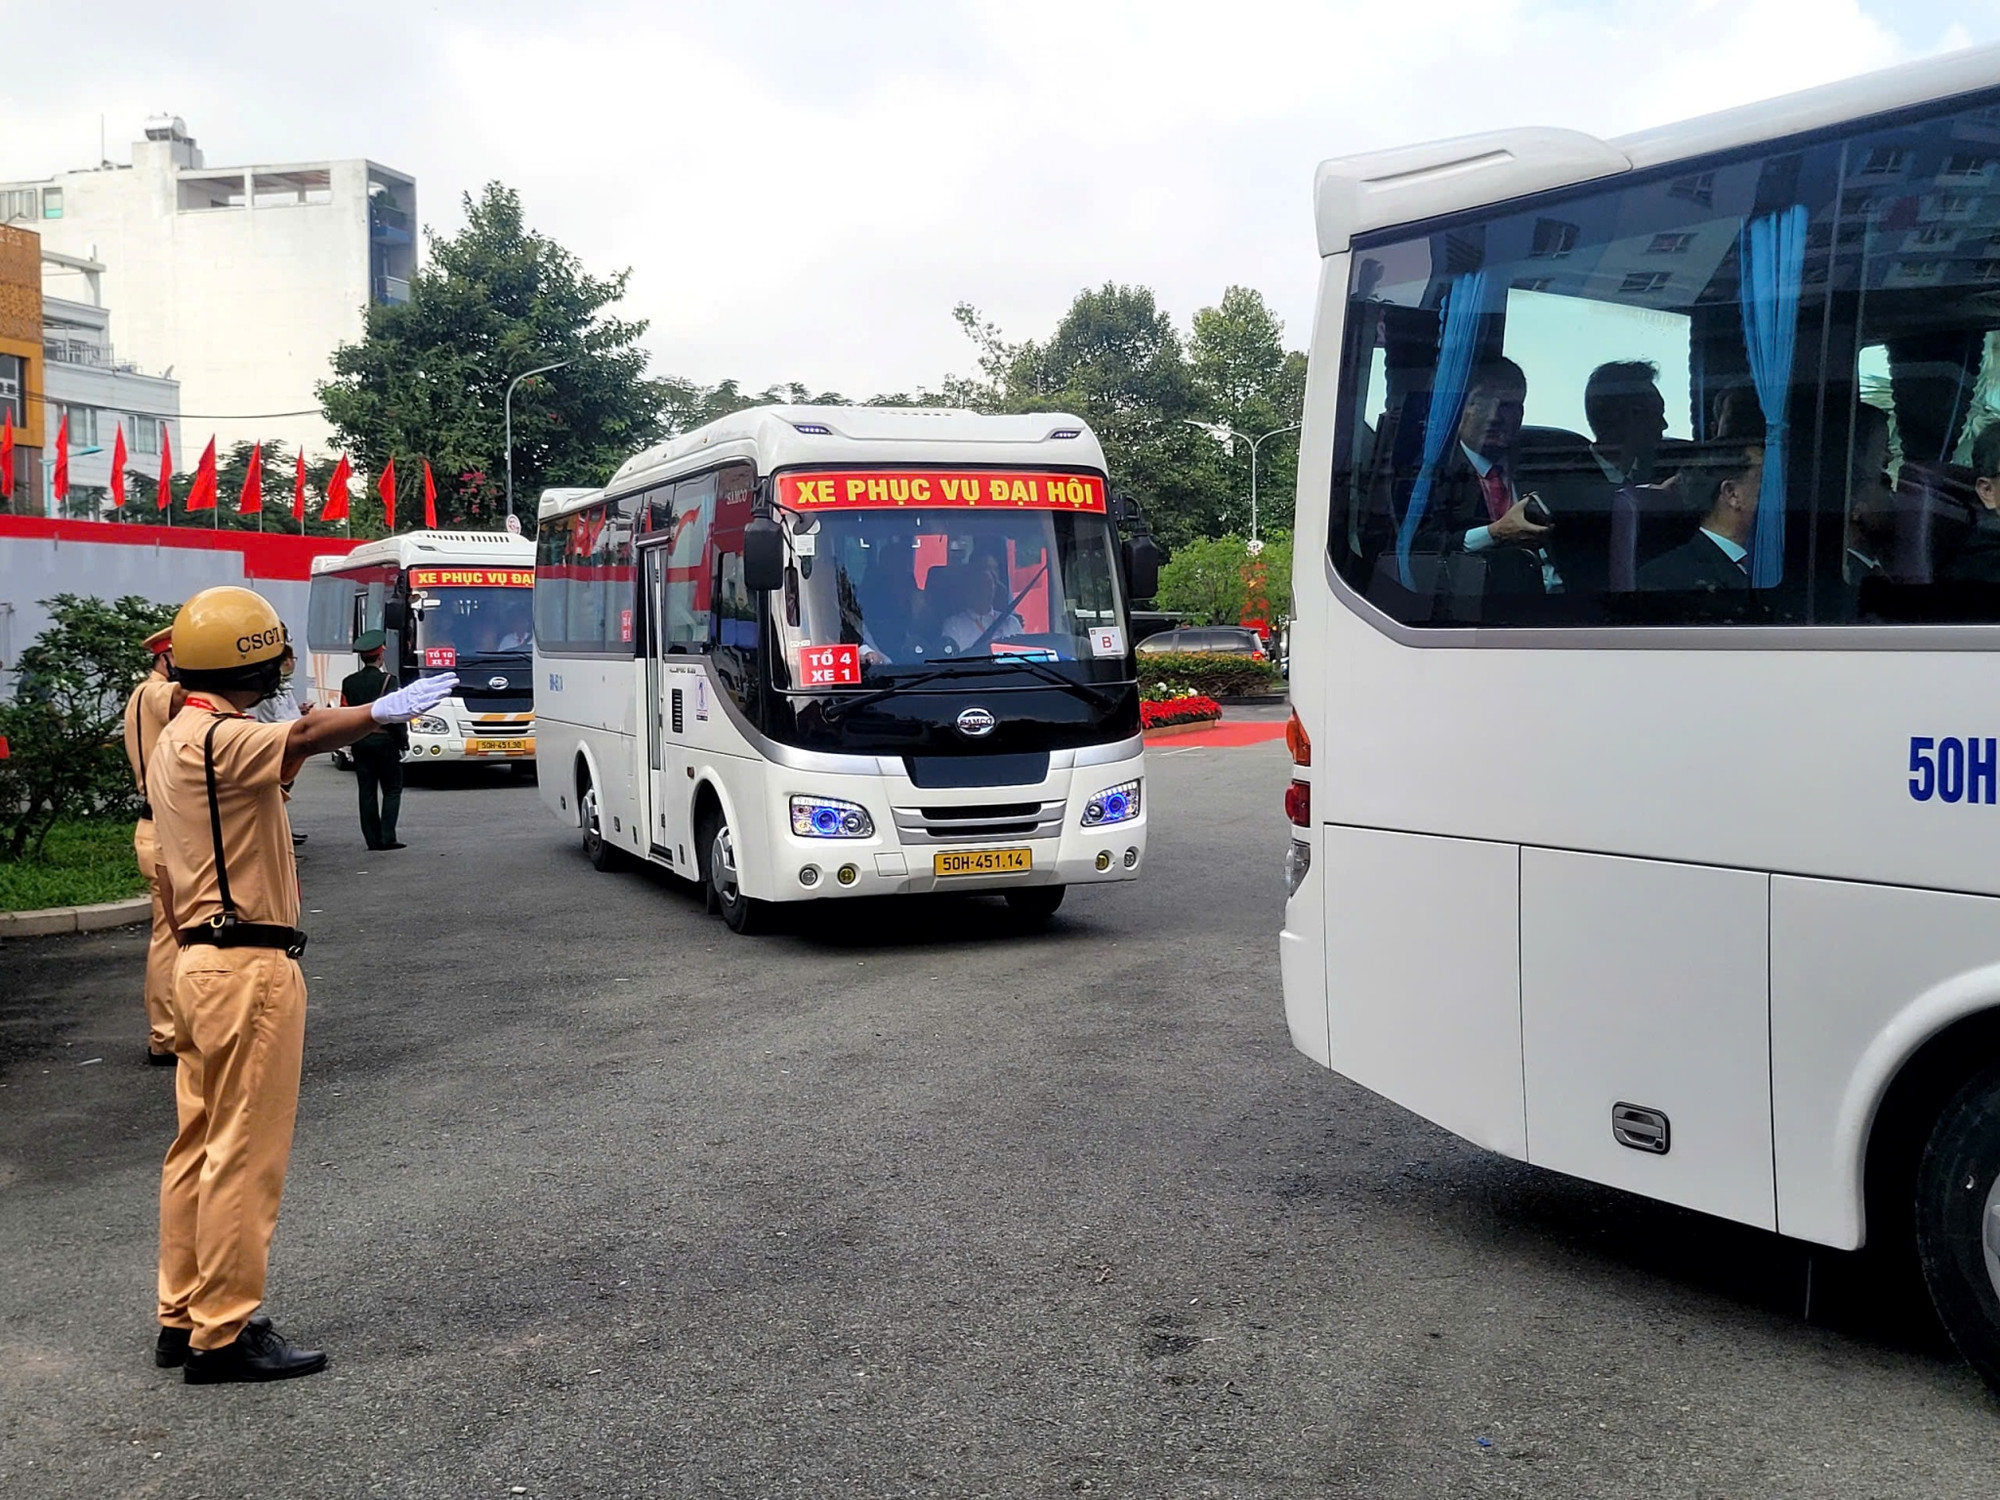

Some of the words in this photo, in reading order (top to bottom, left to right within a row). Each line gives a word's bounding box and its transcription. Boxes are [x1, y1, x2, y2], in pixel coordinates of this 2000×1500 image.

[796, 480, 836, 503] XE
[847, 478, 931, 505] PHỤC
[939, 479, 980, 506] VỤ
[989, 480, 1038, 506] ĐẠI
[1047, 478, 1093, 508] HỘI
[418, 573, 437, 583] XE
[441, 572, 482, 585] PHỤC
[487, 573, 507, 585] VỤ
[809, 649, 834, 666] TỔ
[840, 653, 852, 664] 4
[811, 669, 835, 682] XE
[841, 668, 850, 681] 1
[1908, 736, 1996, 804] 50H
[943, 853, 1023, 871] 50H-451.14
